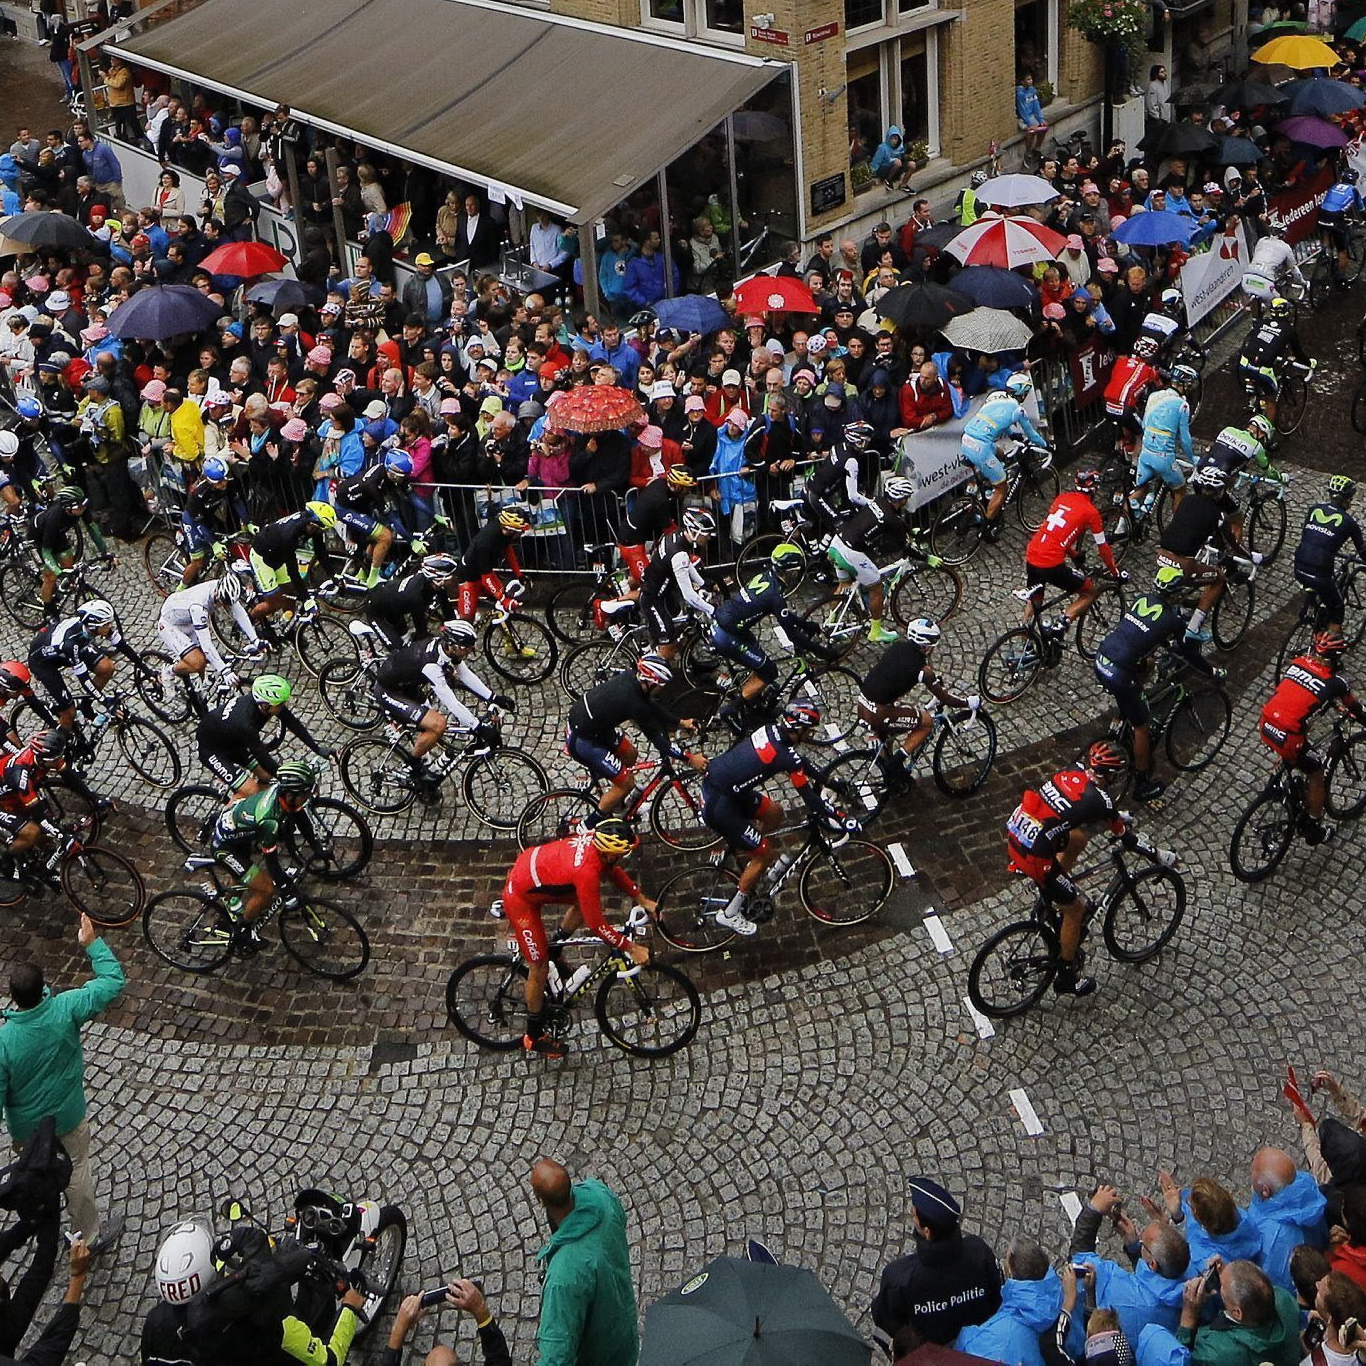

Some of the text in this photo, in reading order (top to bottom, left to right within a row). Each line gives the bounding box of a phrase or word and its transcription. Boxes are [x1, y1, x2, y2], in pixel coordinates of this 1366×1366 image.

[1305, 522, 1336, 537] movistar
[1286, 664, 1326, 693] BMC
[1263, 722, 1288, 741] BMC
[604, 752, 622, 771] IAM
[1041, 780, 1073, 813] BMC
[744, 825, 762, 846] IAM
[1016, 815, 1039, 840] 146
[1045, 821, 1072, 841] BMC
[1055, 874, 1076, 894] BMC
[522, 929, 541, 962] Cofidis
[159, 1273, 202, 1303] FRED
[914, 1286, 987, 1315] Police Politie
